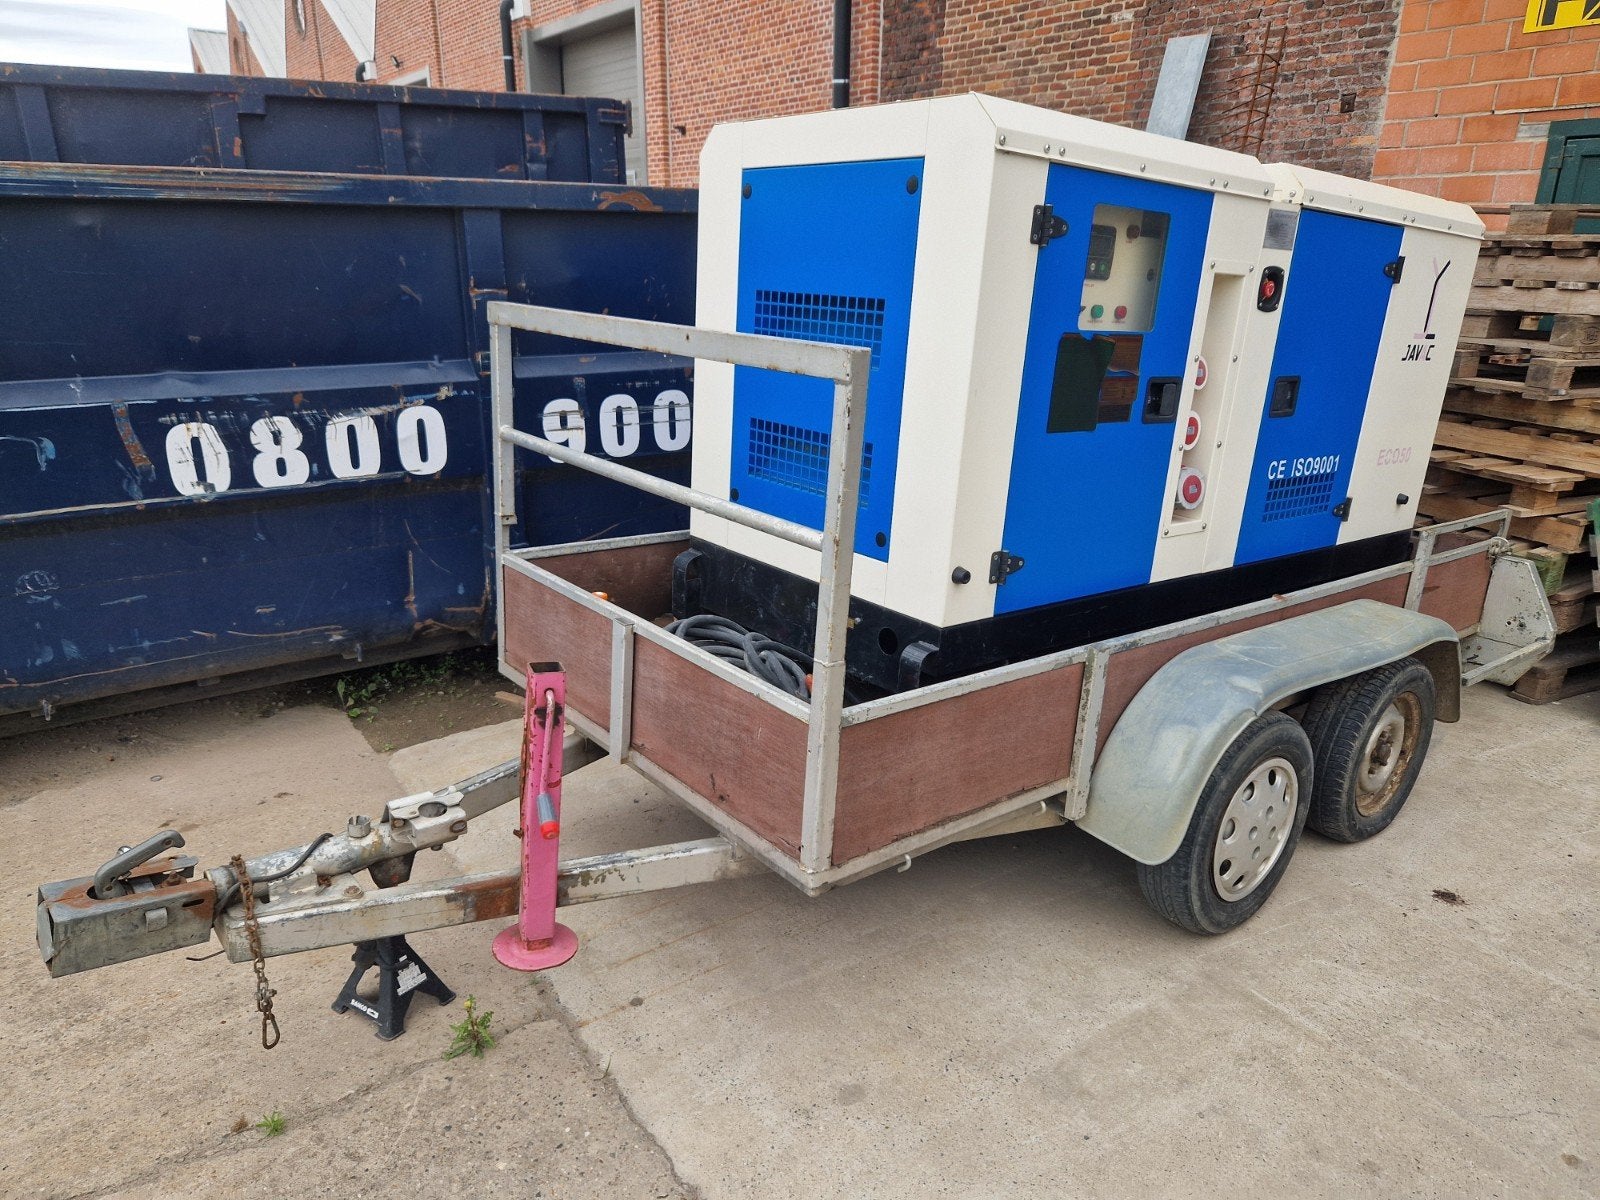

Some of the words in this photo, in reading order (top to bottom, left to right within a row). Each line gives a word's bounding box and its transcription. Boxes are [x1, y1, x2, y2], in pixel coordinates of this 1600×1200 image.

[165, 404, 448, 497] 0800
[542, 389, 691, 464] 900
[1268, 460, 1287, 479] CE
[1291, 454, 1340, 477] ISO9001
